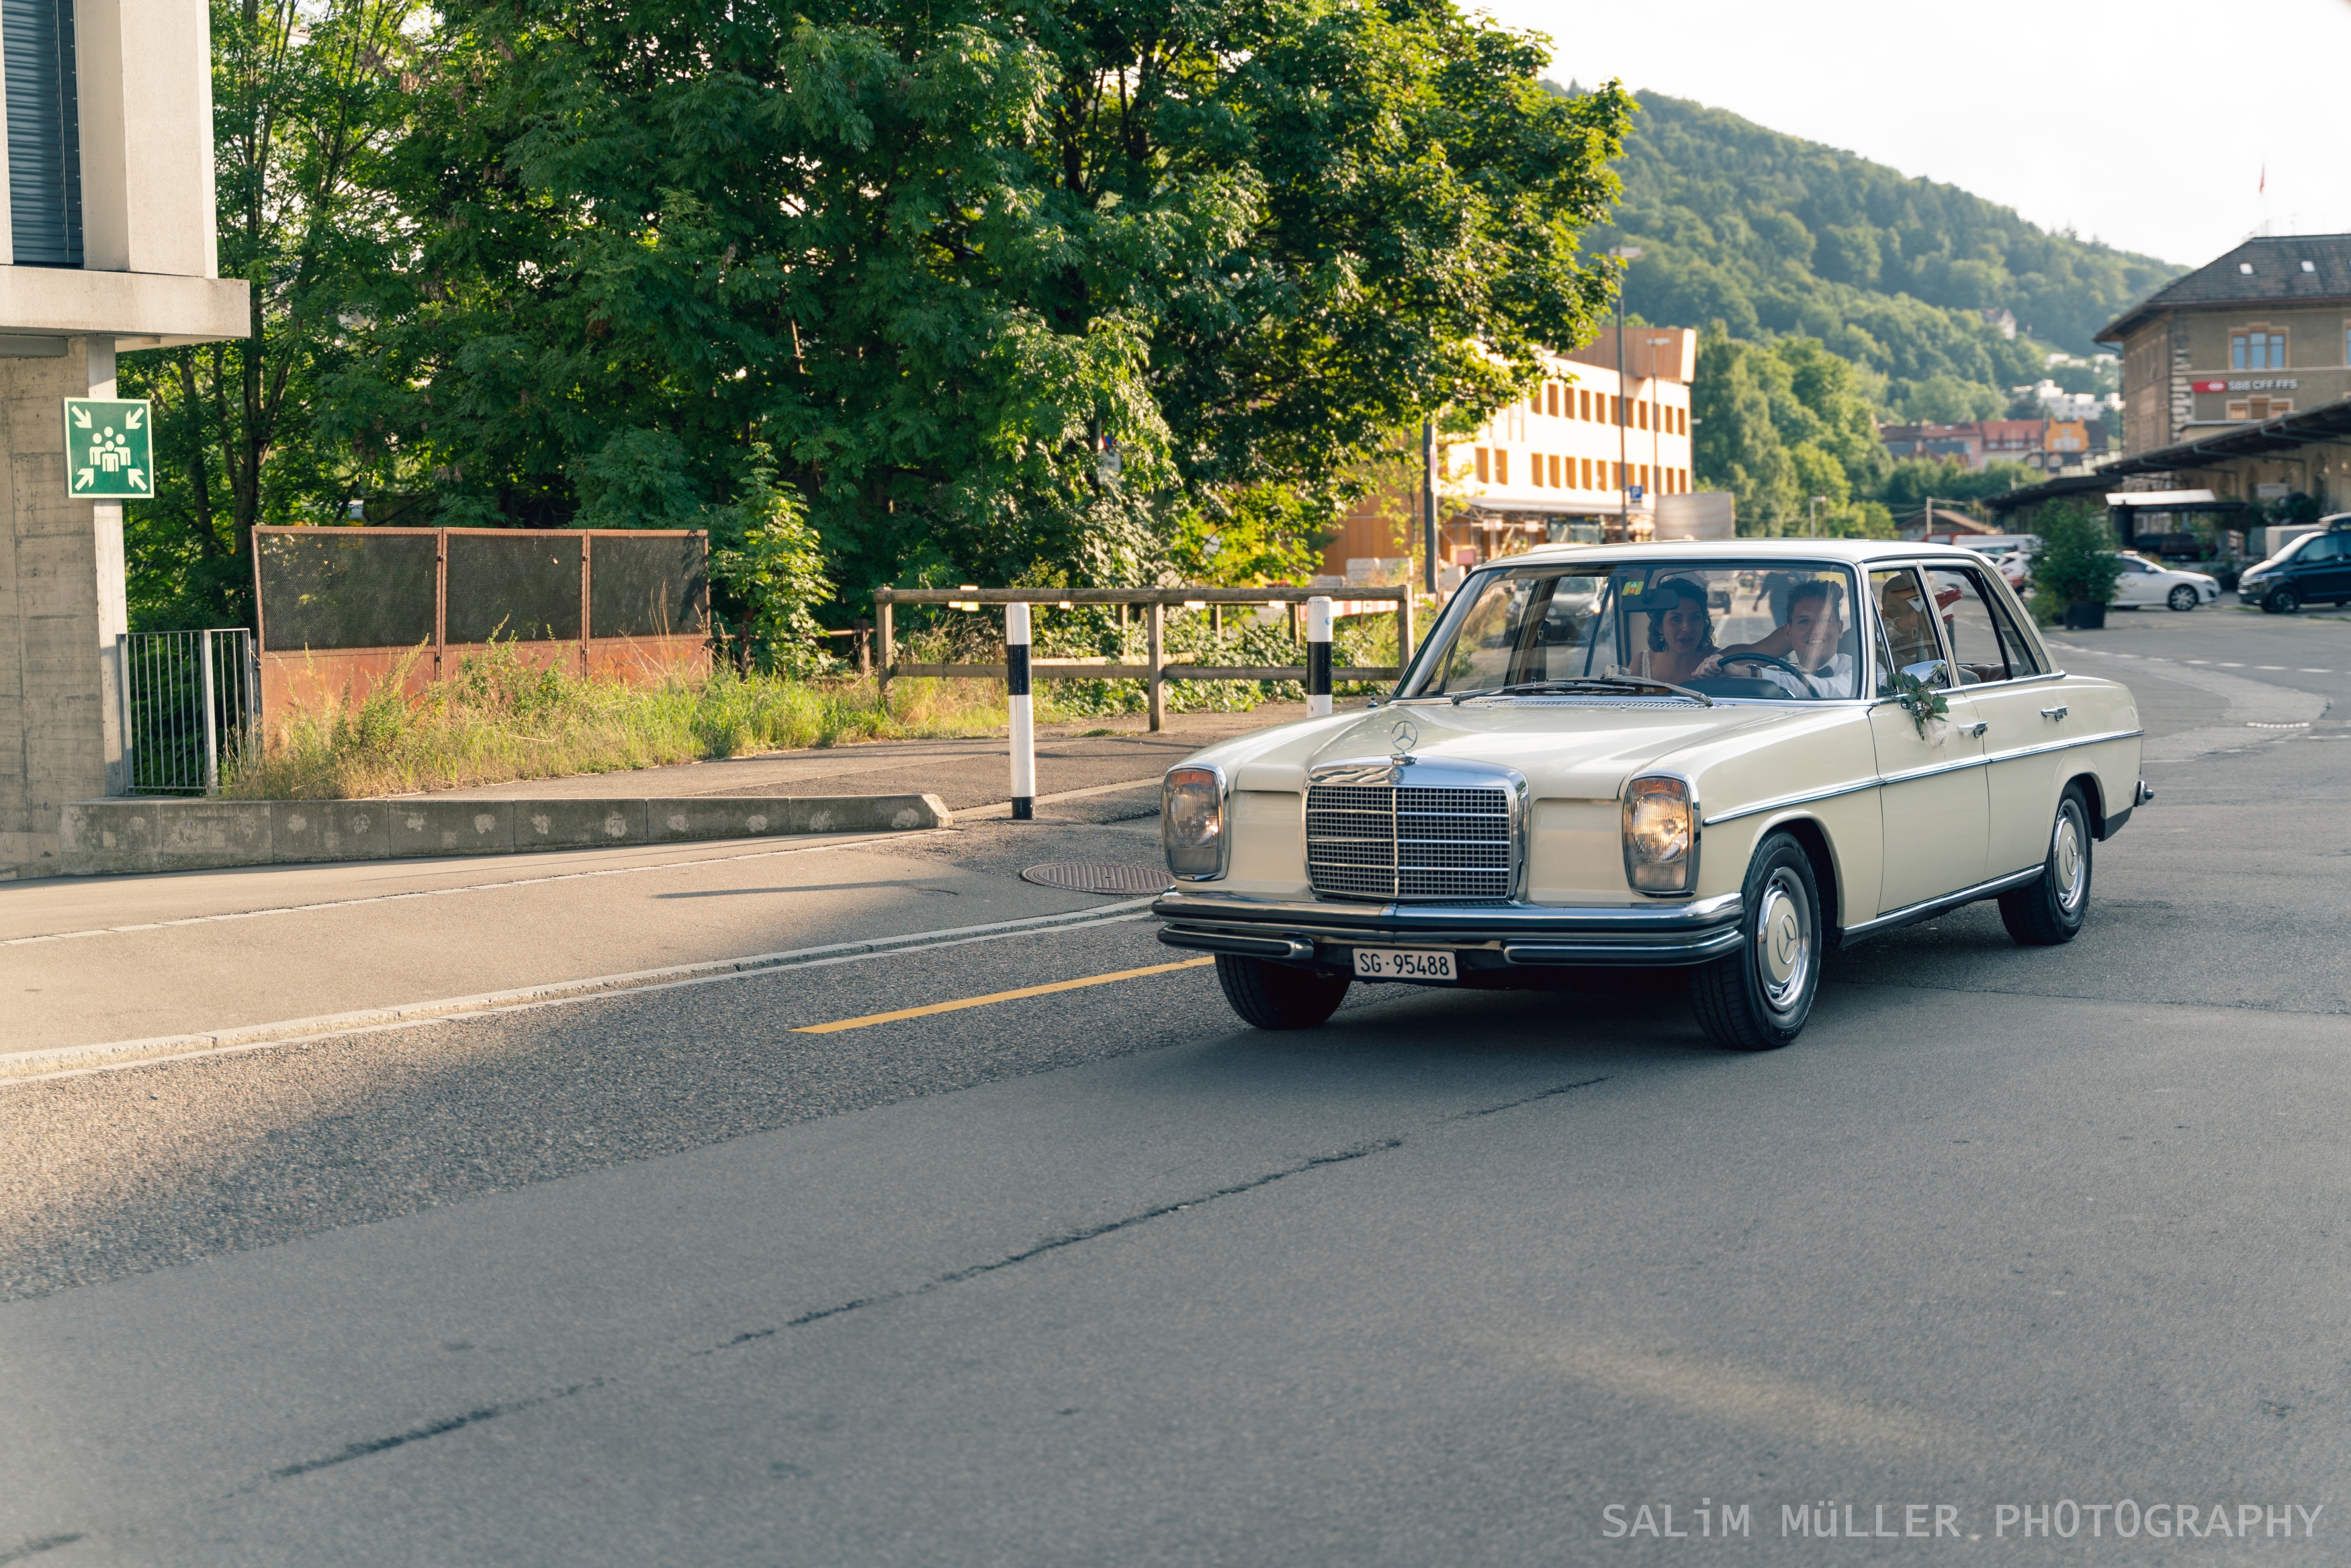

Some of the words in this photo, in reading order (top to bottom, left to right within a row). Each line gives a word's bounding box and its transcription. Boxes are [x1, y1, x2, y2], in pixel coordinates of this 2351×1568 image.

[2227, 380, 2251, 391] SBB
[2252, 379, 2274, 390] CFF
[2275, 379, 2298, 389] FFS
